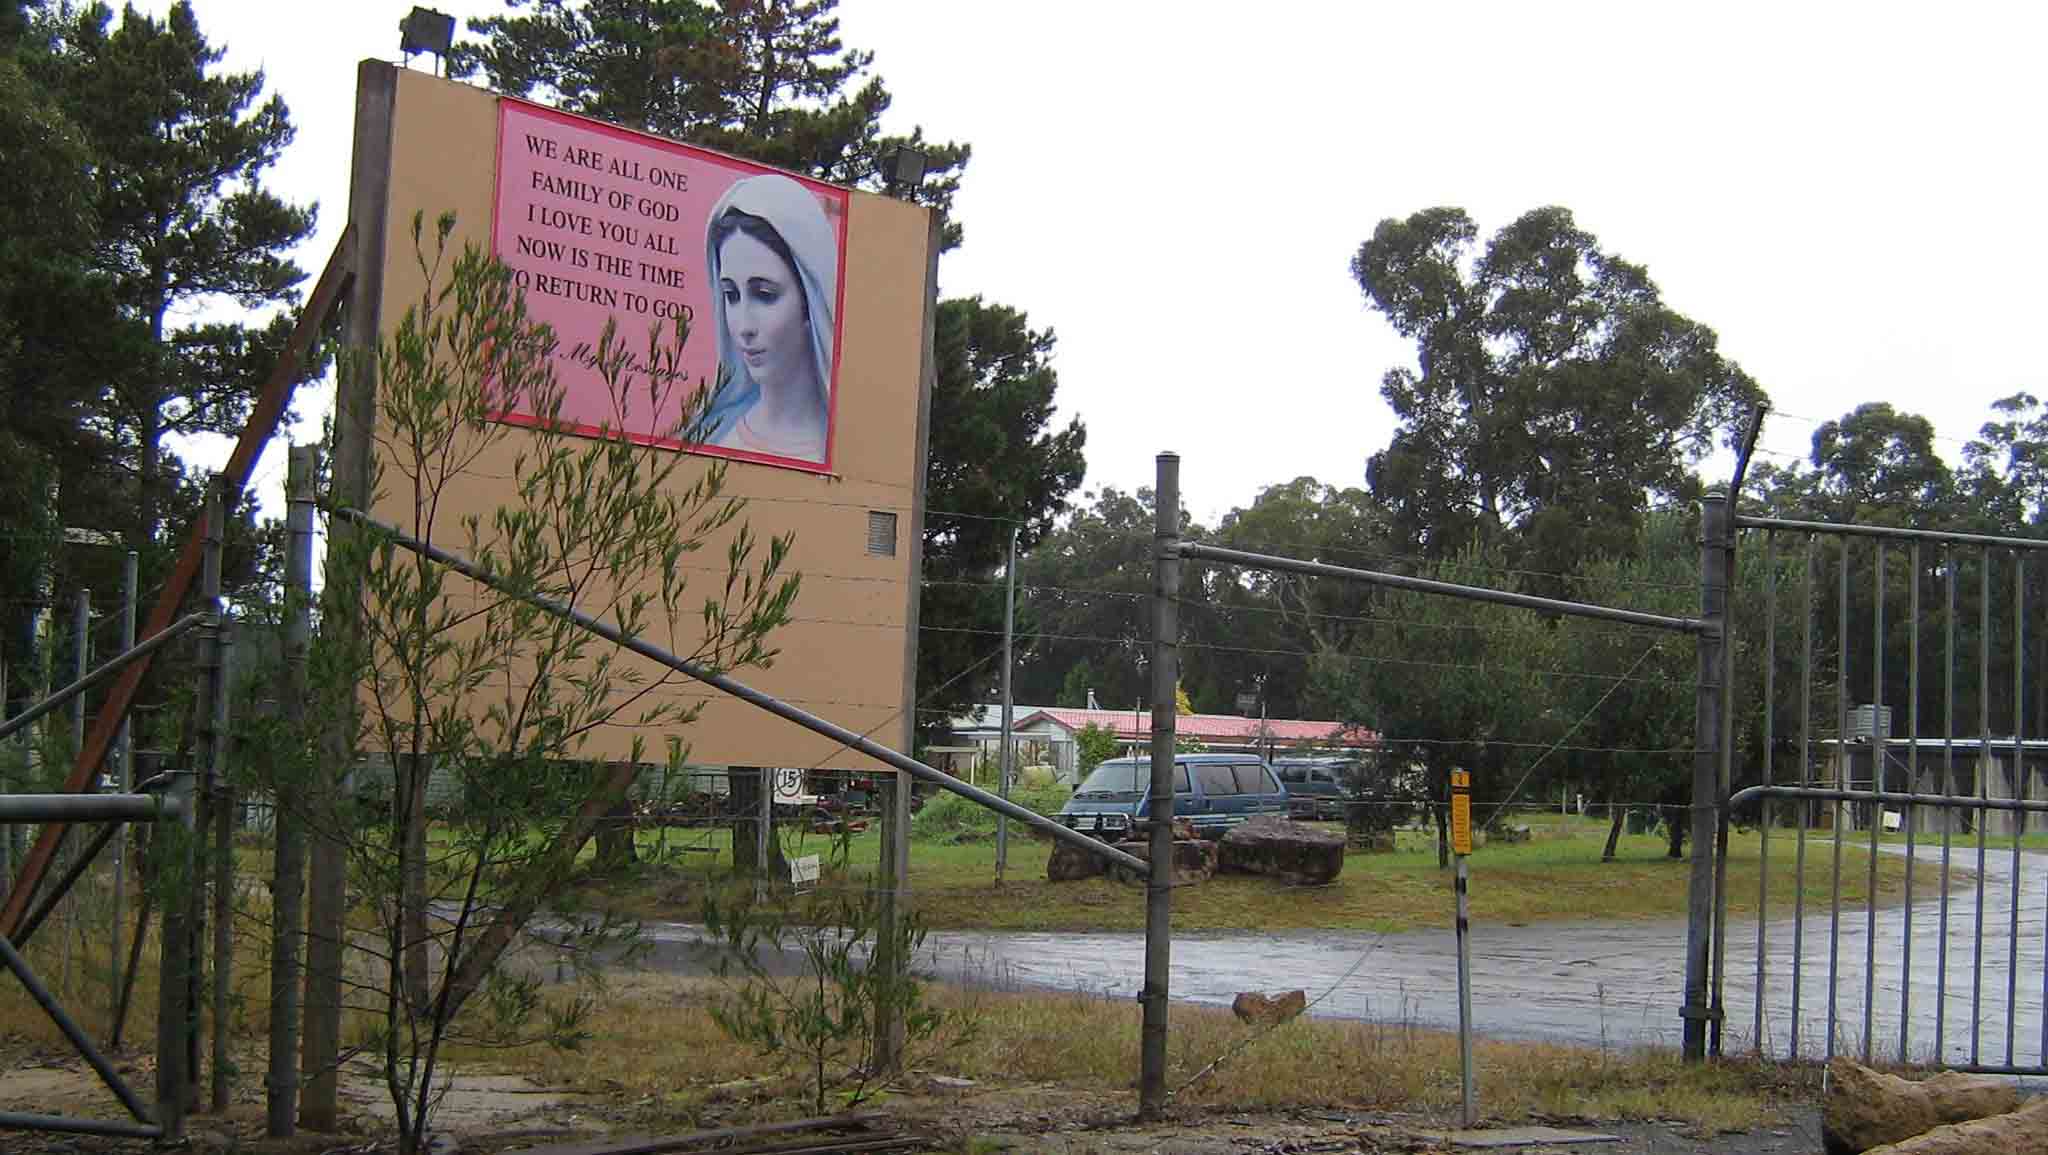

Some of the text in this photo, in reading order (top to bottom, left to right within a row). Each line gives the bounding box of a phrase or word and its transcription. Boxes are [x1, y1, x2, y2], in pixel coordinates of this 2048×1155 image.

[525, 134, 688, 192] WE ARE ALL ONE
[532, 171, 679, 222] FAMILY OF GOD
[528, 204, 680, 256] I LOVE YOU ALL
[517, 235, 686, 289] NOW IS THE TIME
[536, 273, 618, 308] RETURN
[623, 292, 648, 314] TO
[653, 300, 694, 322] GOD
[783, 770, 797, 788] 15
